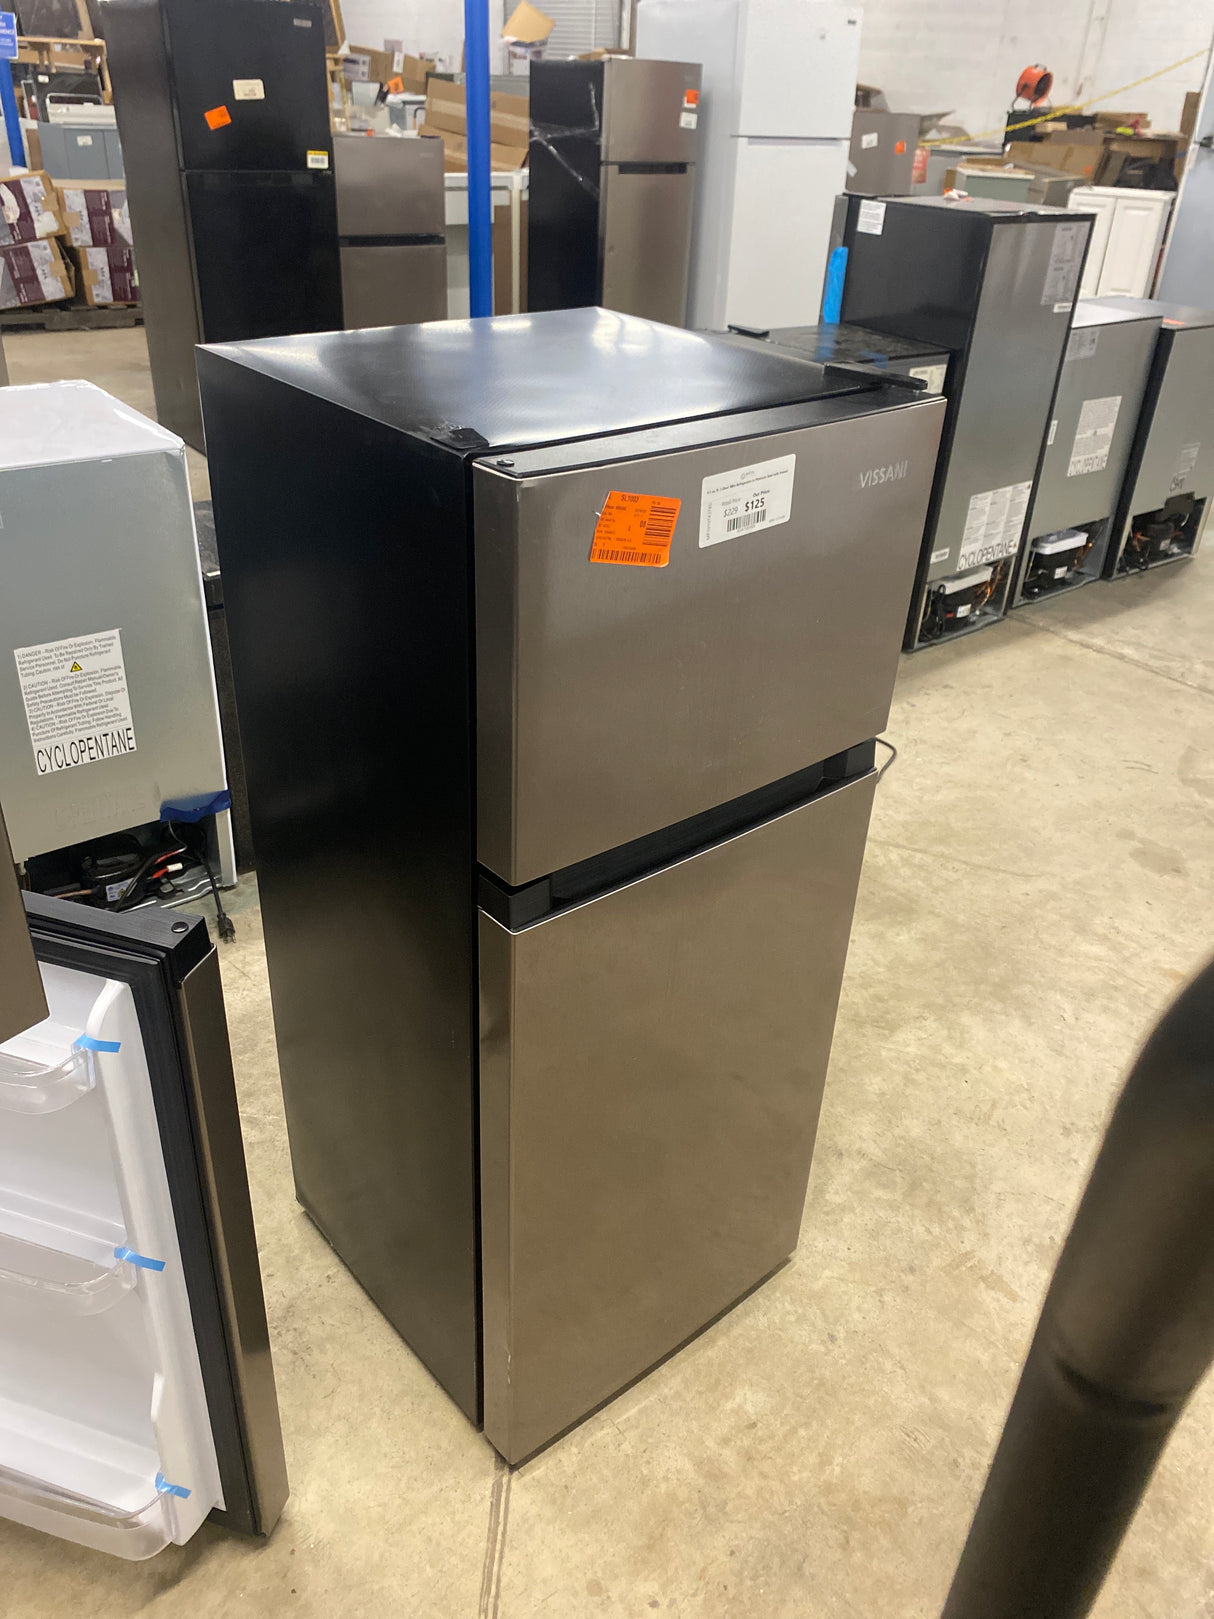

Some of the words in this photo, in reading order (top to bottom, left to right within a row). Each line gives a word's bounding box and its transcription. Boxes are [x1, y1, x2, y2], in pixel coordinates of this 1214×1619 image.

[858, 460, 908, 489] VISSANI
[724, 506, 738, 517] $229
[745, 498, 765, 512] $125
[958, 540, 1013, 569] CYCLOPENTANE
[37, 728, 134, 772] CYCLOPENTANE
